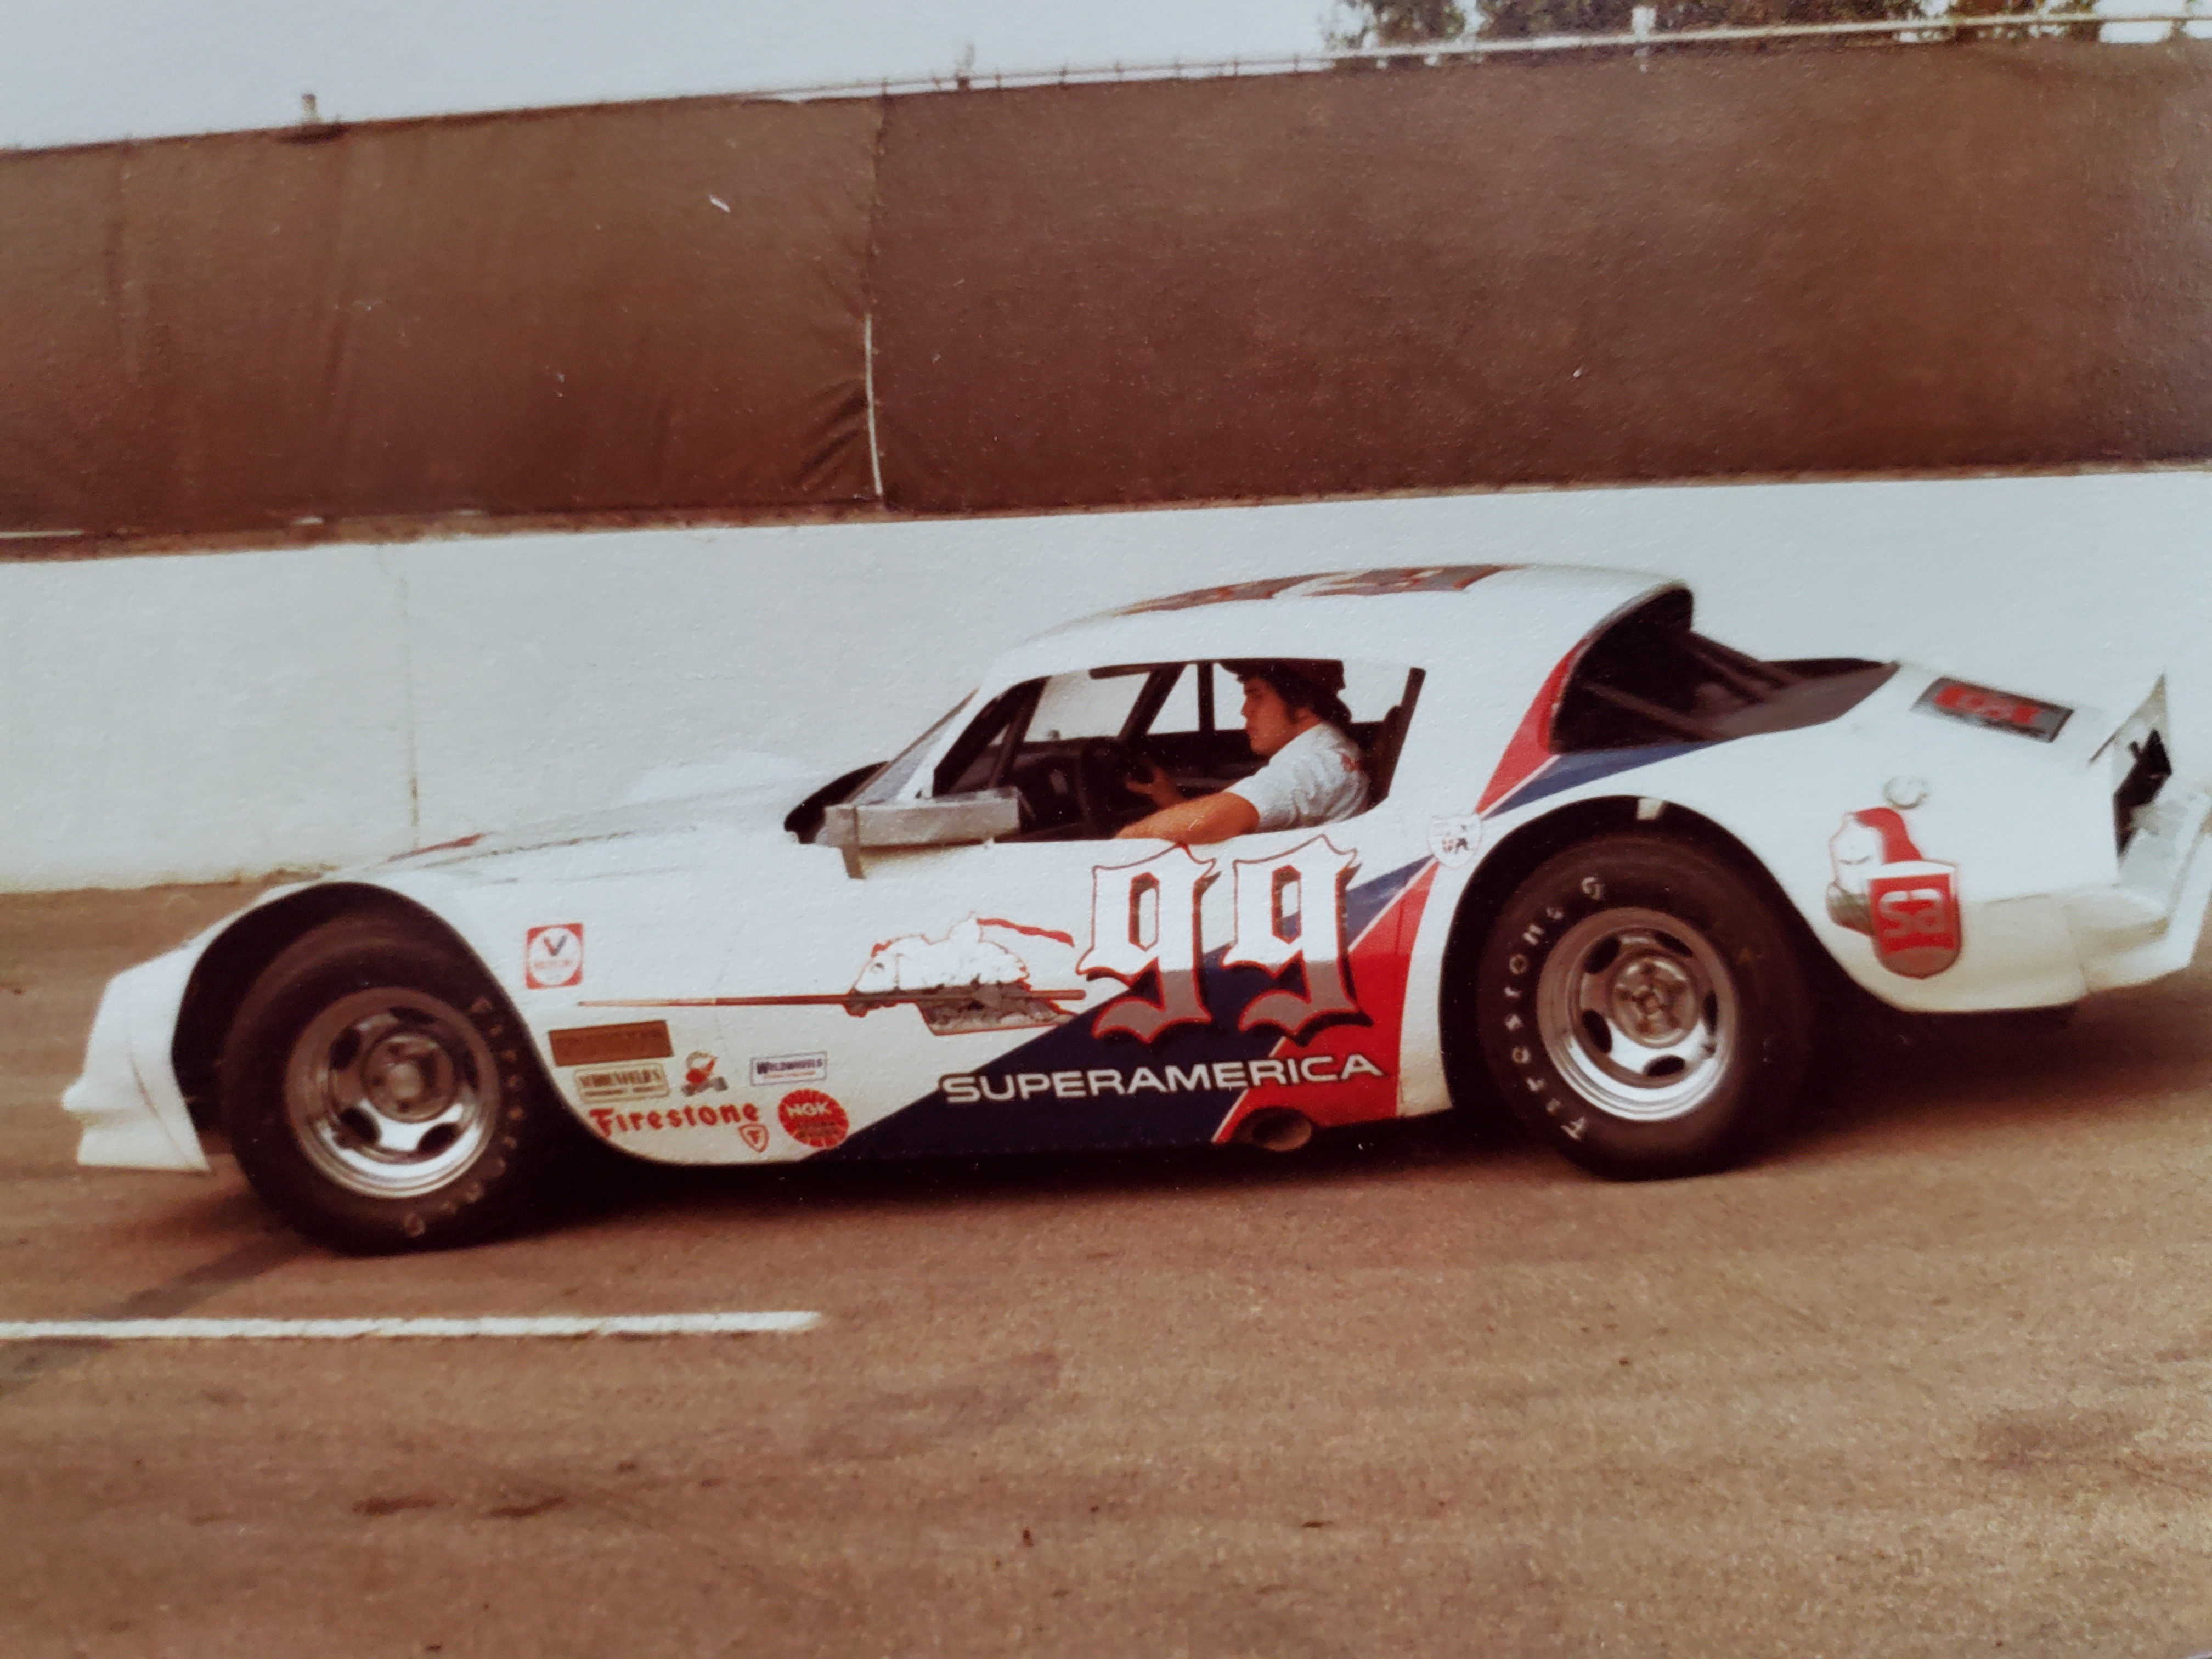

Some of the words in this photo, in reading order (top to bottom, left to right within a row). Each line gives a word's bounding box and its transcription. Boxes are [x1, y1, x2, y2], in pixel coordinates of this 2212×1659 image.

[1076, 834, 1374, 1047] 99
[941, 1053, 1383, 1103] SUPERAMERICA
[588, 1103, 759, 1138] Firestone
[785, 1101, 833, 1120] NGK
